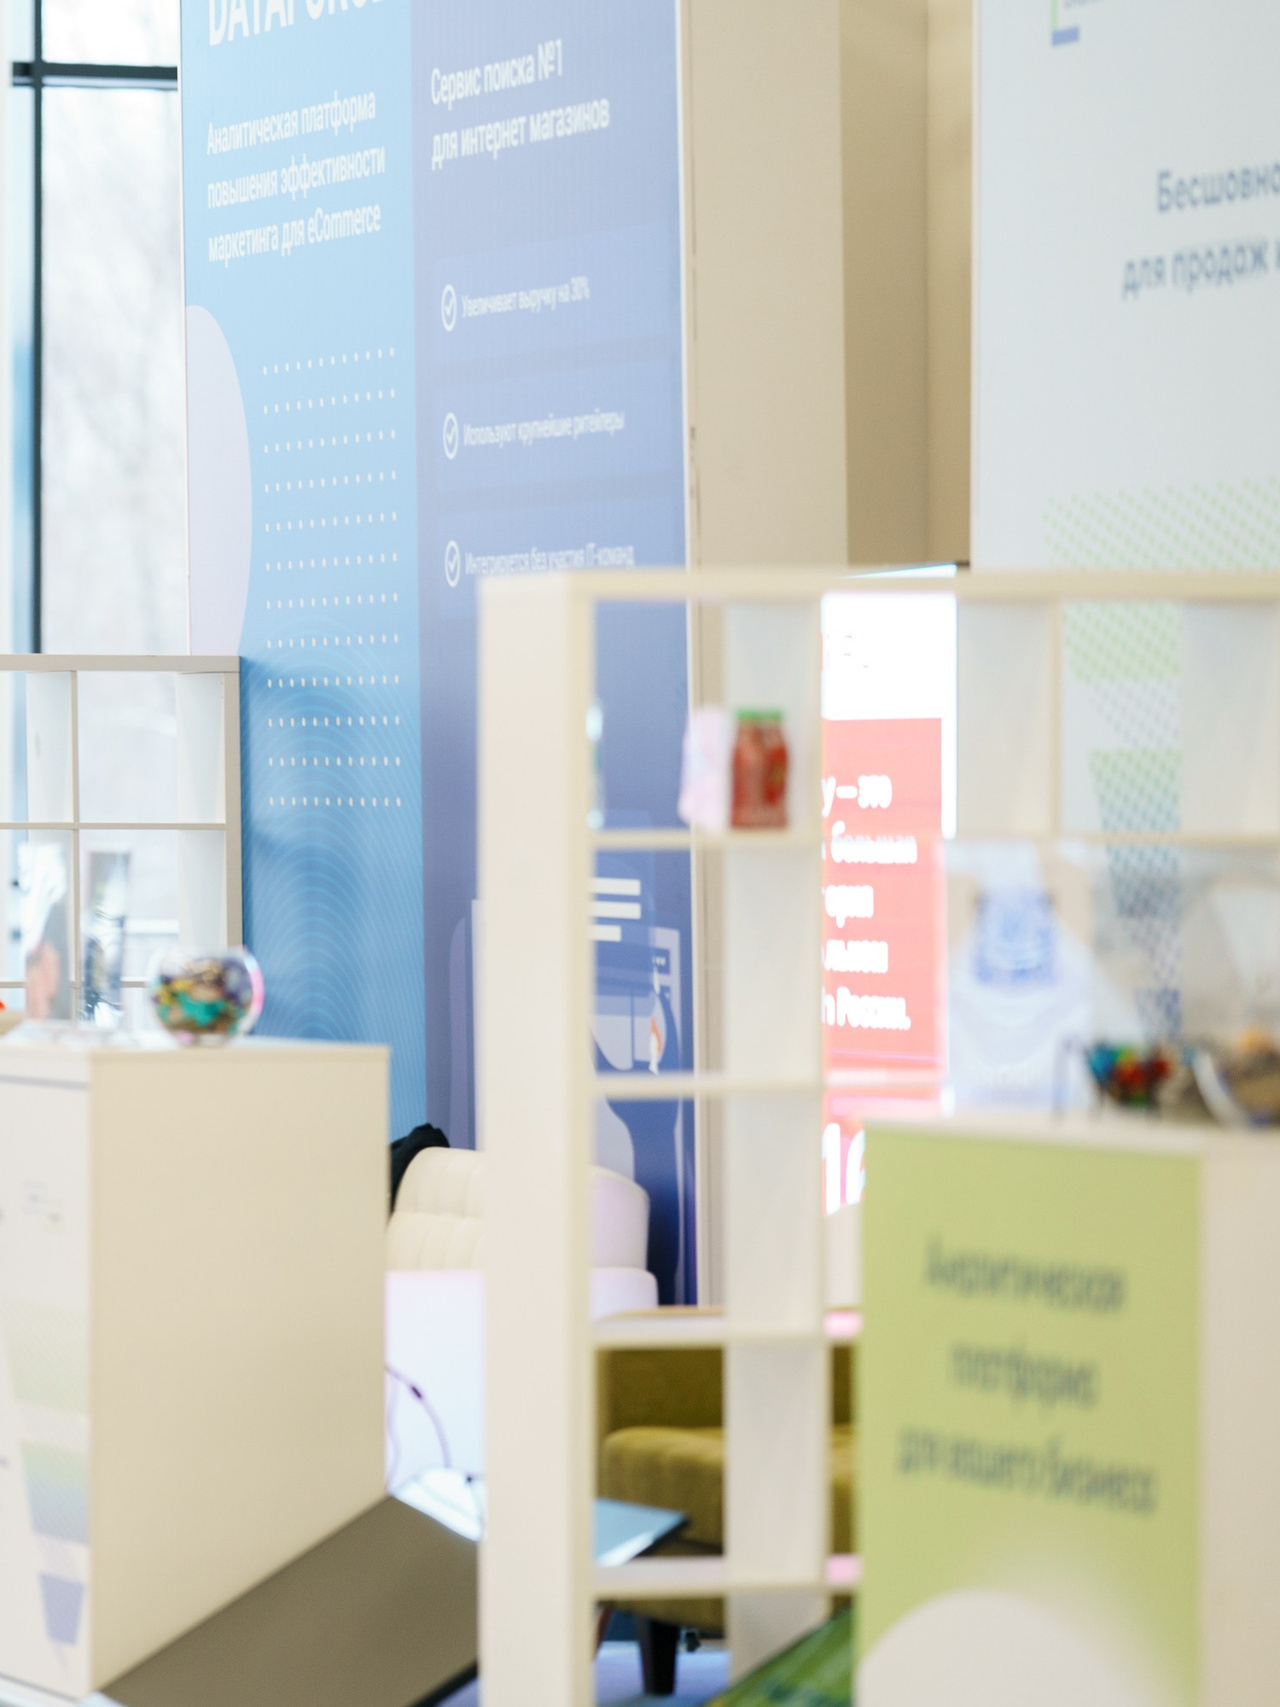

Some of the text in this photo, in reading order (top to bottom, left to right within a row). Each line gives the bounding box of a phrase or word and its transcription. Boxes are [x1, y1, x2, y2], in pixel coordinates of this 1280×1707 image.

[431, 38, 563, 111] Сервис поиска №1
[207, 89, 376, 156] Аналитическая платформа
[431, 98, 610, 172] для интернет магазинов
[208, 147, 386, 209] повышения эффективности
[208, 204, 381, 268] маркетинга для eCommerce
[1122, 256, 1166, 301] для
